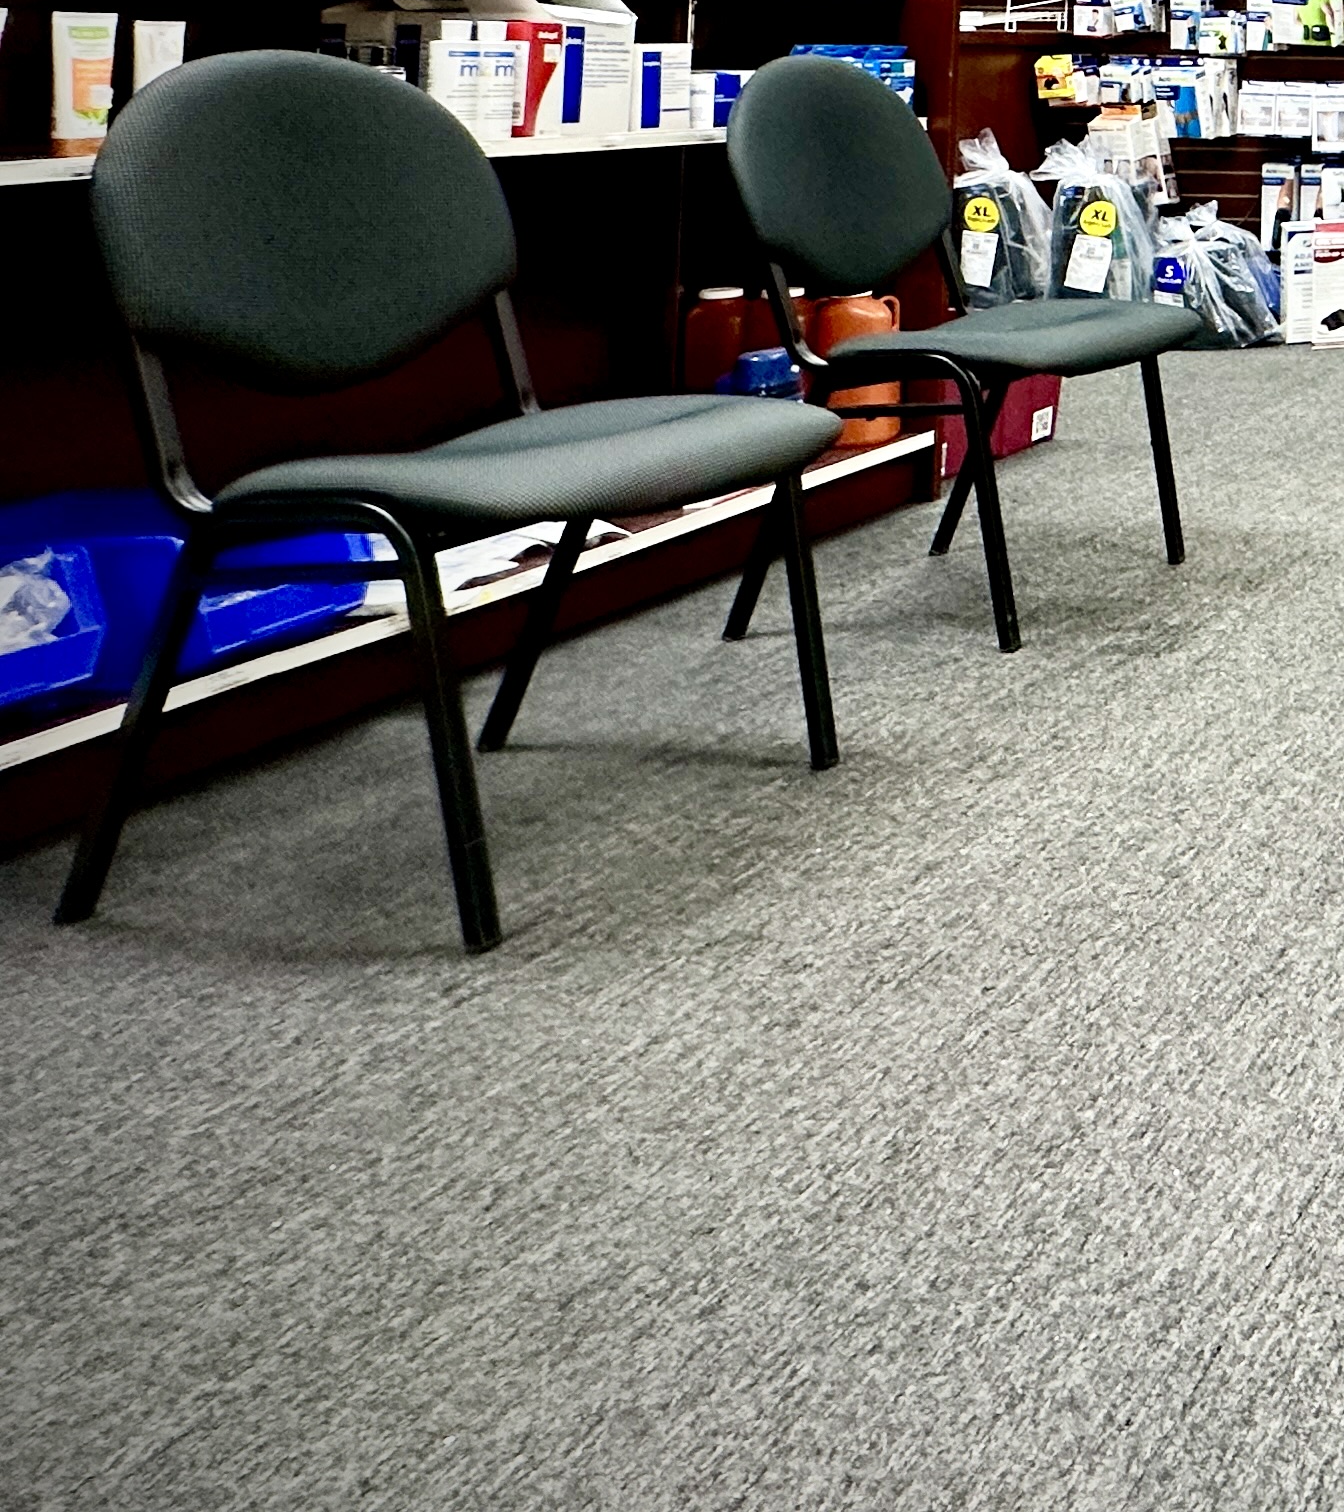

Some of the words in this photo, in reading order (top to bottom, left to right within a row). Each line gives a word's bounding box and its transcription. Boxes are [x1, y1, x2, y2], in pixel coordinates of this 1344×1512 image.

[972, 205, 991, 217] XL
[1091, 209, 1109, 222] XL
[1164, 264, 1174, 278] S
